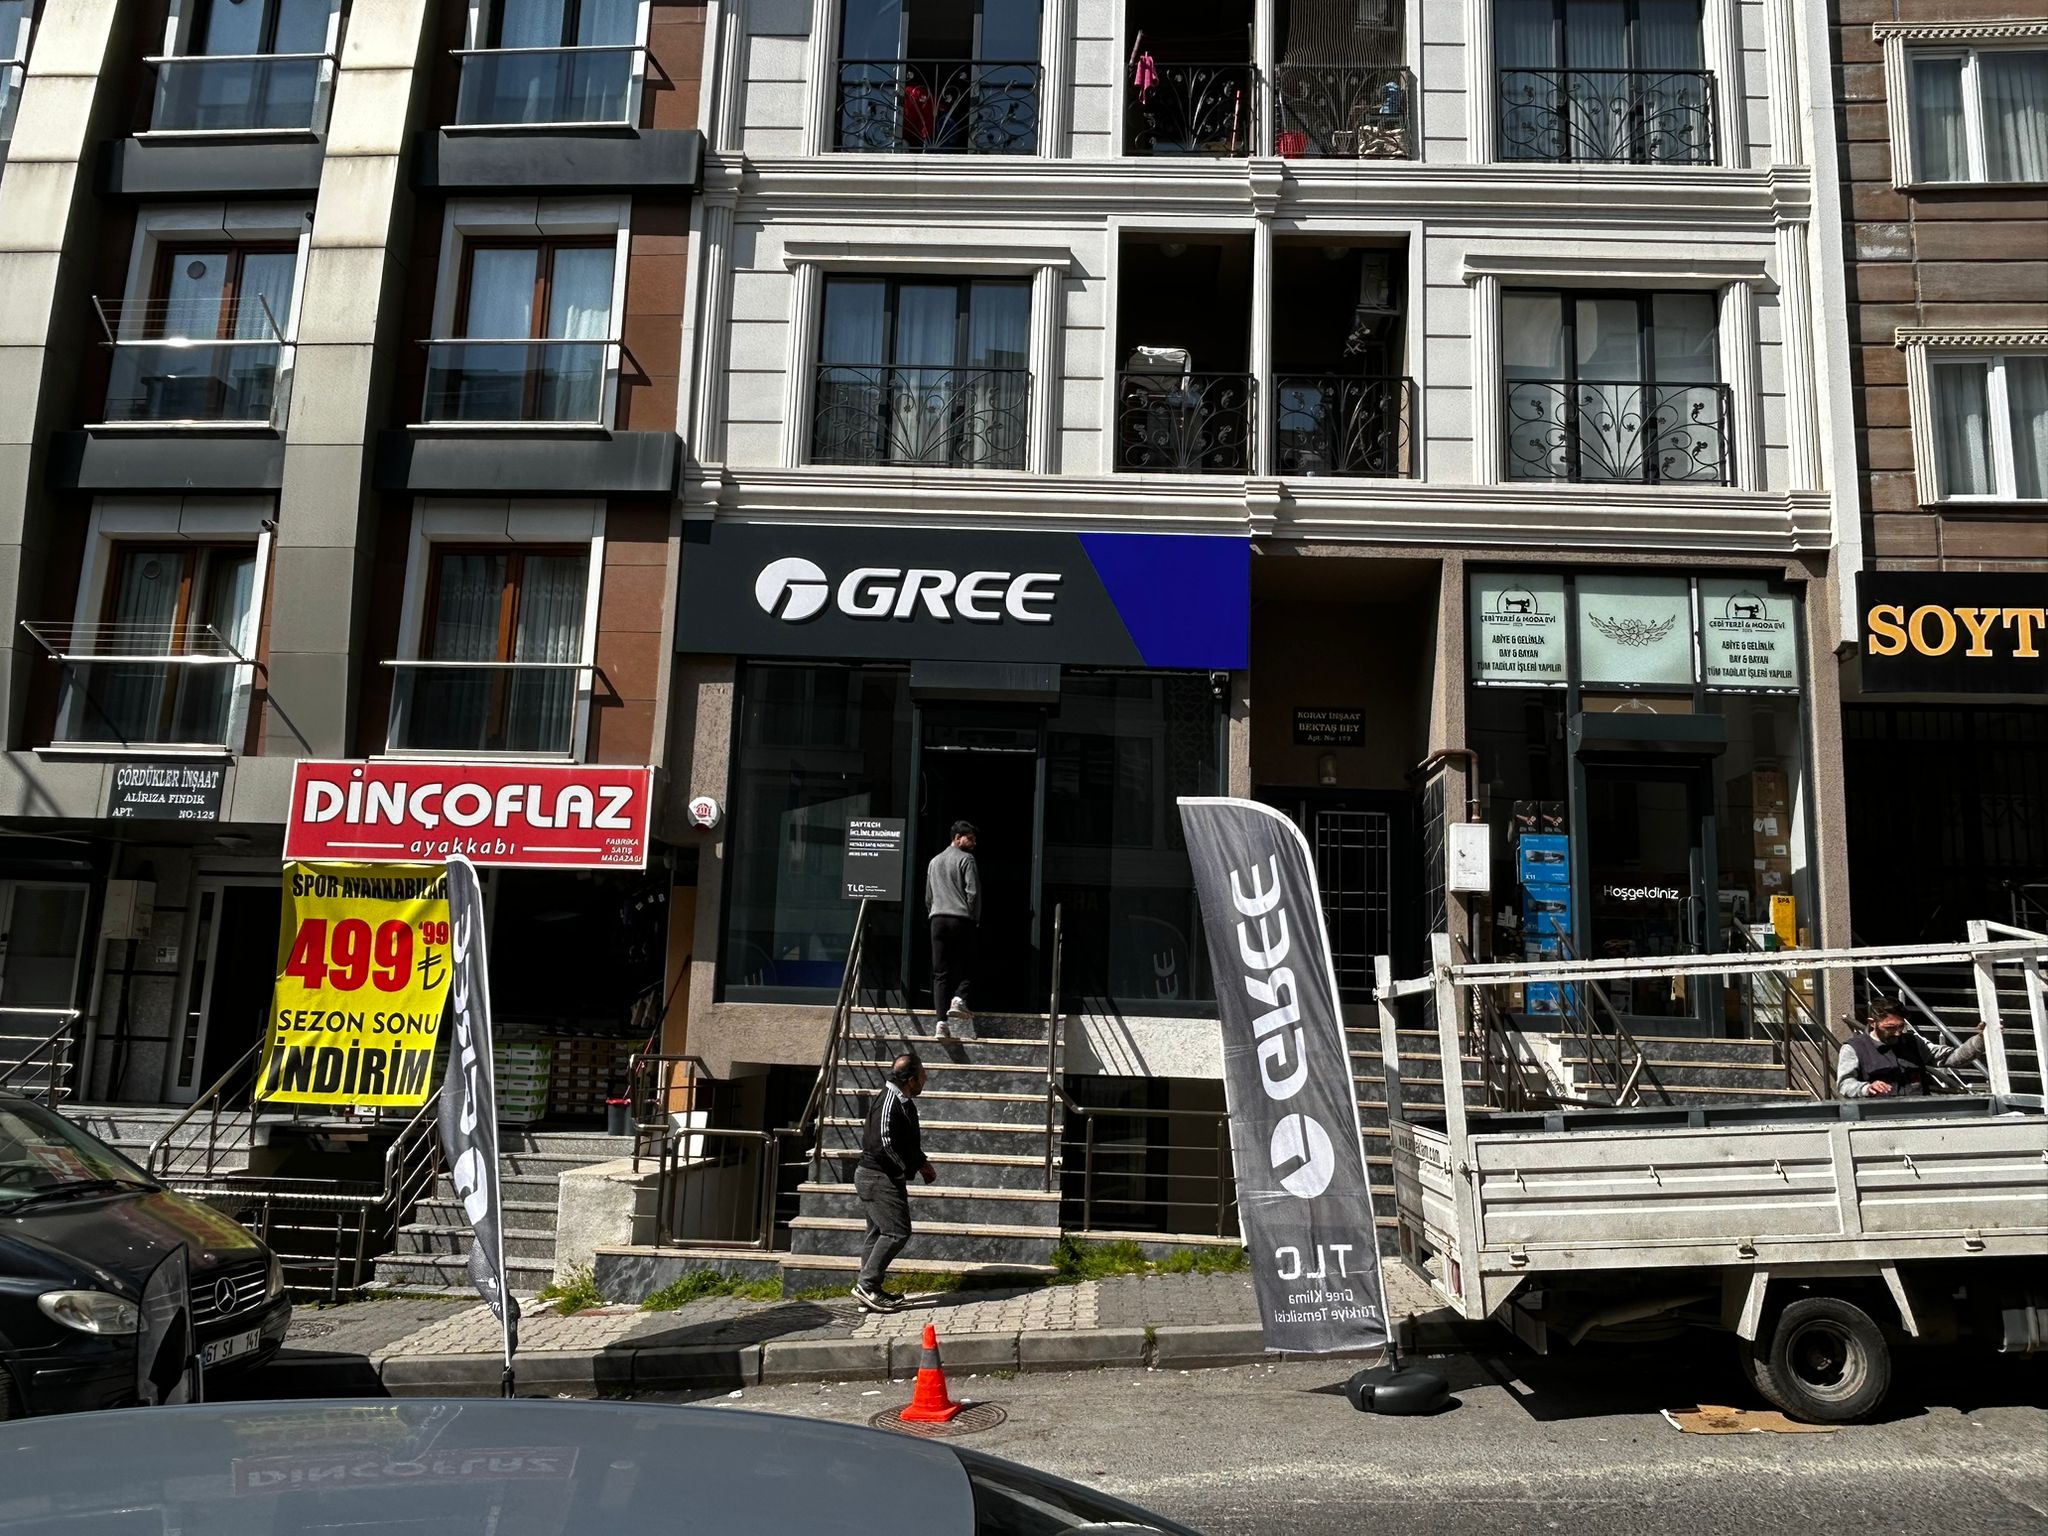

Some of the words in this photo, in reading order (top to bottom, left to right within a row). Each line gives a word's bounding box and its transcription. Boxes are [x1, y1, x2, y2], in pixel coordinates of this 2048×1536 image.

[837, 567, 1062, 622] GREE
[1867, 604, 2048, 658] SOYT
[1518, 649, 1539, 658] BAYAN
[1749, 655, 1769, 664] BAYAN
[117, 764, 180, 790] ÇÖRDÜKLER
[181, 766, 219, 792] İNŞAAT
[168, 794, 205, 805] FINDIK
[302, 768, 634, 830] DİNÇOFLAZ
[111, 807, 135, 817] APT.
[178, 809, 215, 820] NO:125
[409, 836, 515, 858] ayakkabı
[292, 873, 339, 898] SPOR
[341, 876, 449, 900] AYAKKABILAR
[847, 884, 864, 892] TLC
[1603, 885, 1679, 901] Hoşgeldiniz
[285, 918, 414, 993] 499
[277, 1008, 365, 1033] SEZON
[372, 1011, 440, 1035] SONU
[264, 1036, 432, 1095] İNDİRİM
[207, 1343, 218, 1363] 61
[222, 1338, 234, 1358] SA
